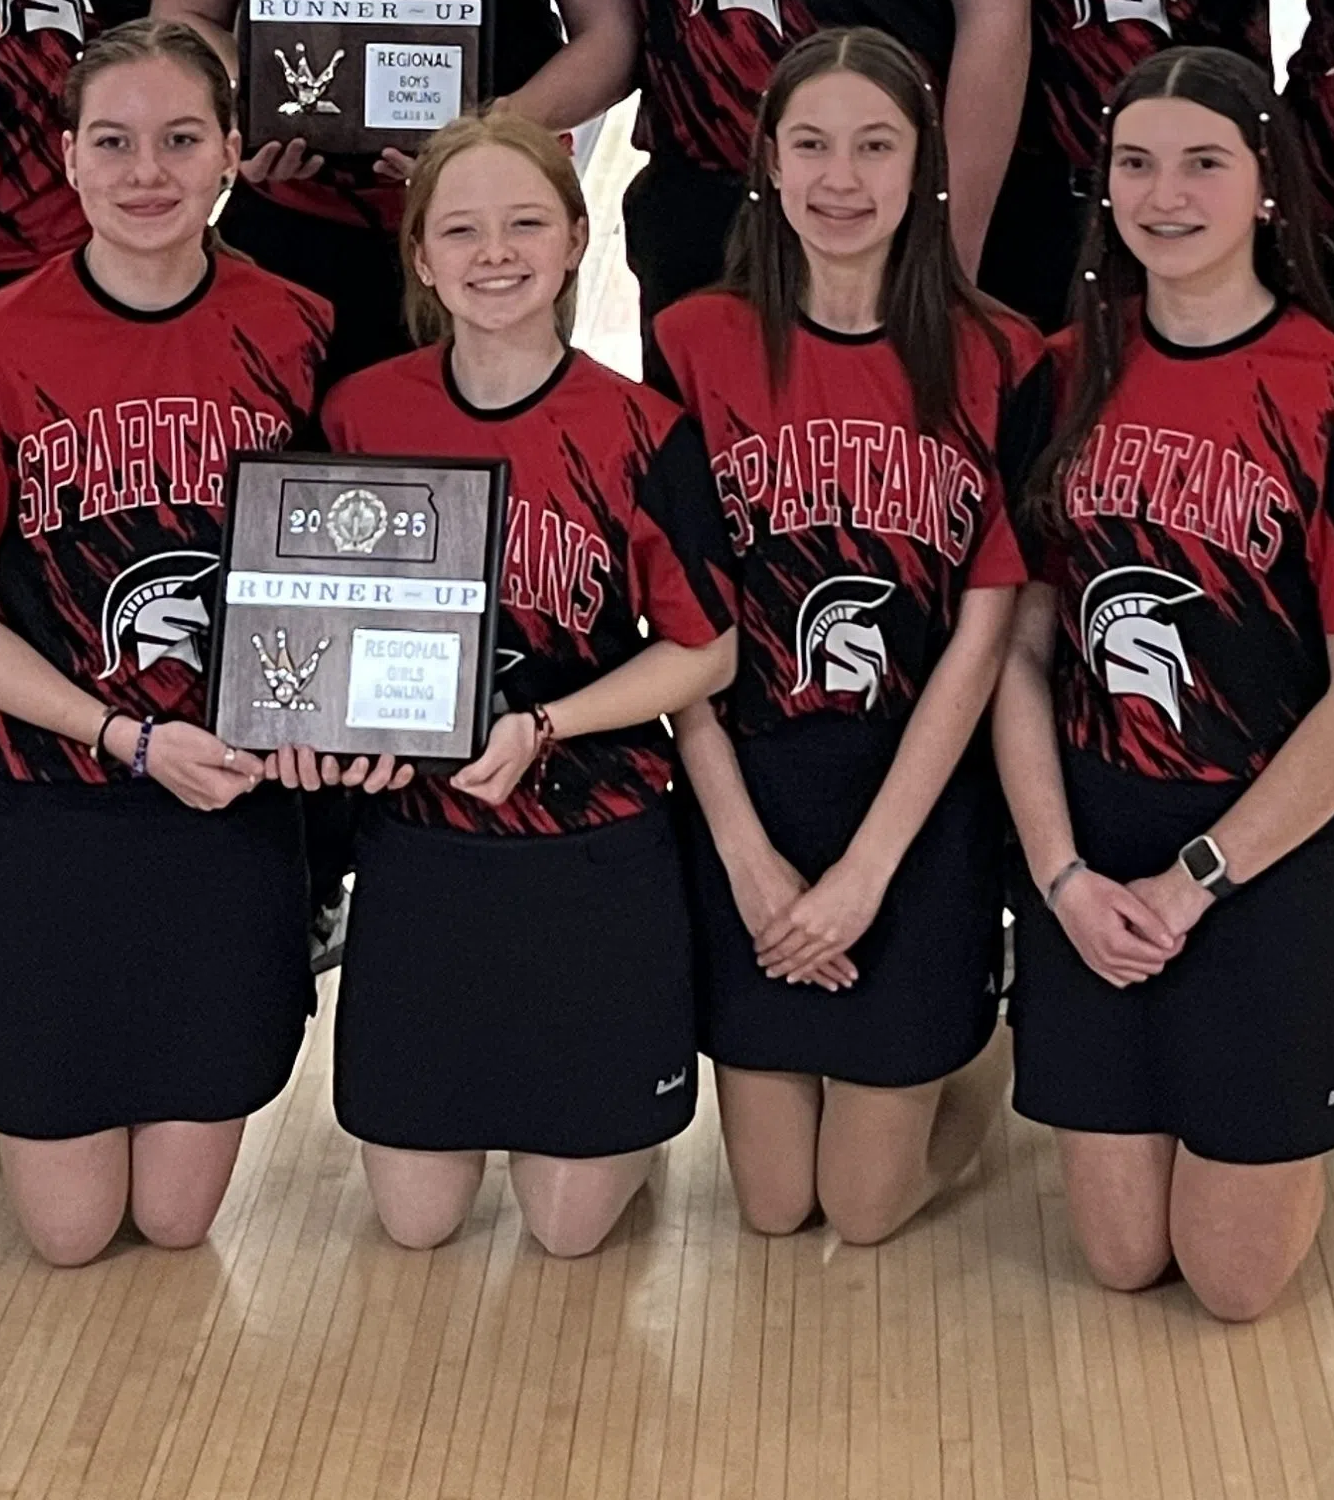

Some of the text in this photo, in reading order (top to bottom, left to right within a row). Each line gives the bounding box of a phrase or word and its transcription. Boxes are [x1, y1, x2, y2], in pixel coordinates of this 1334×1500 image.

[377, 51, 453, 69] REGIONAL
[399, 75, 430, 89] BOYS
[388, 90, 441, 104] BOWLING
[710, 418, 984, 563] SPARTANS
[1066, 423, 1289, 573] ARTANS
[289, 509, 322, 533] 20
[365, 639, 450, 660] REGIONAL
[387, 665, 425, 682] GIRLS
[374, 684, 435, 701] BOWLING
